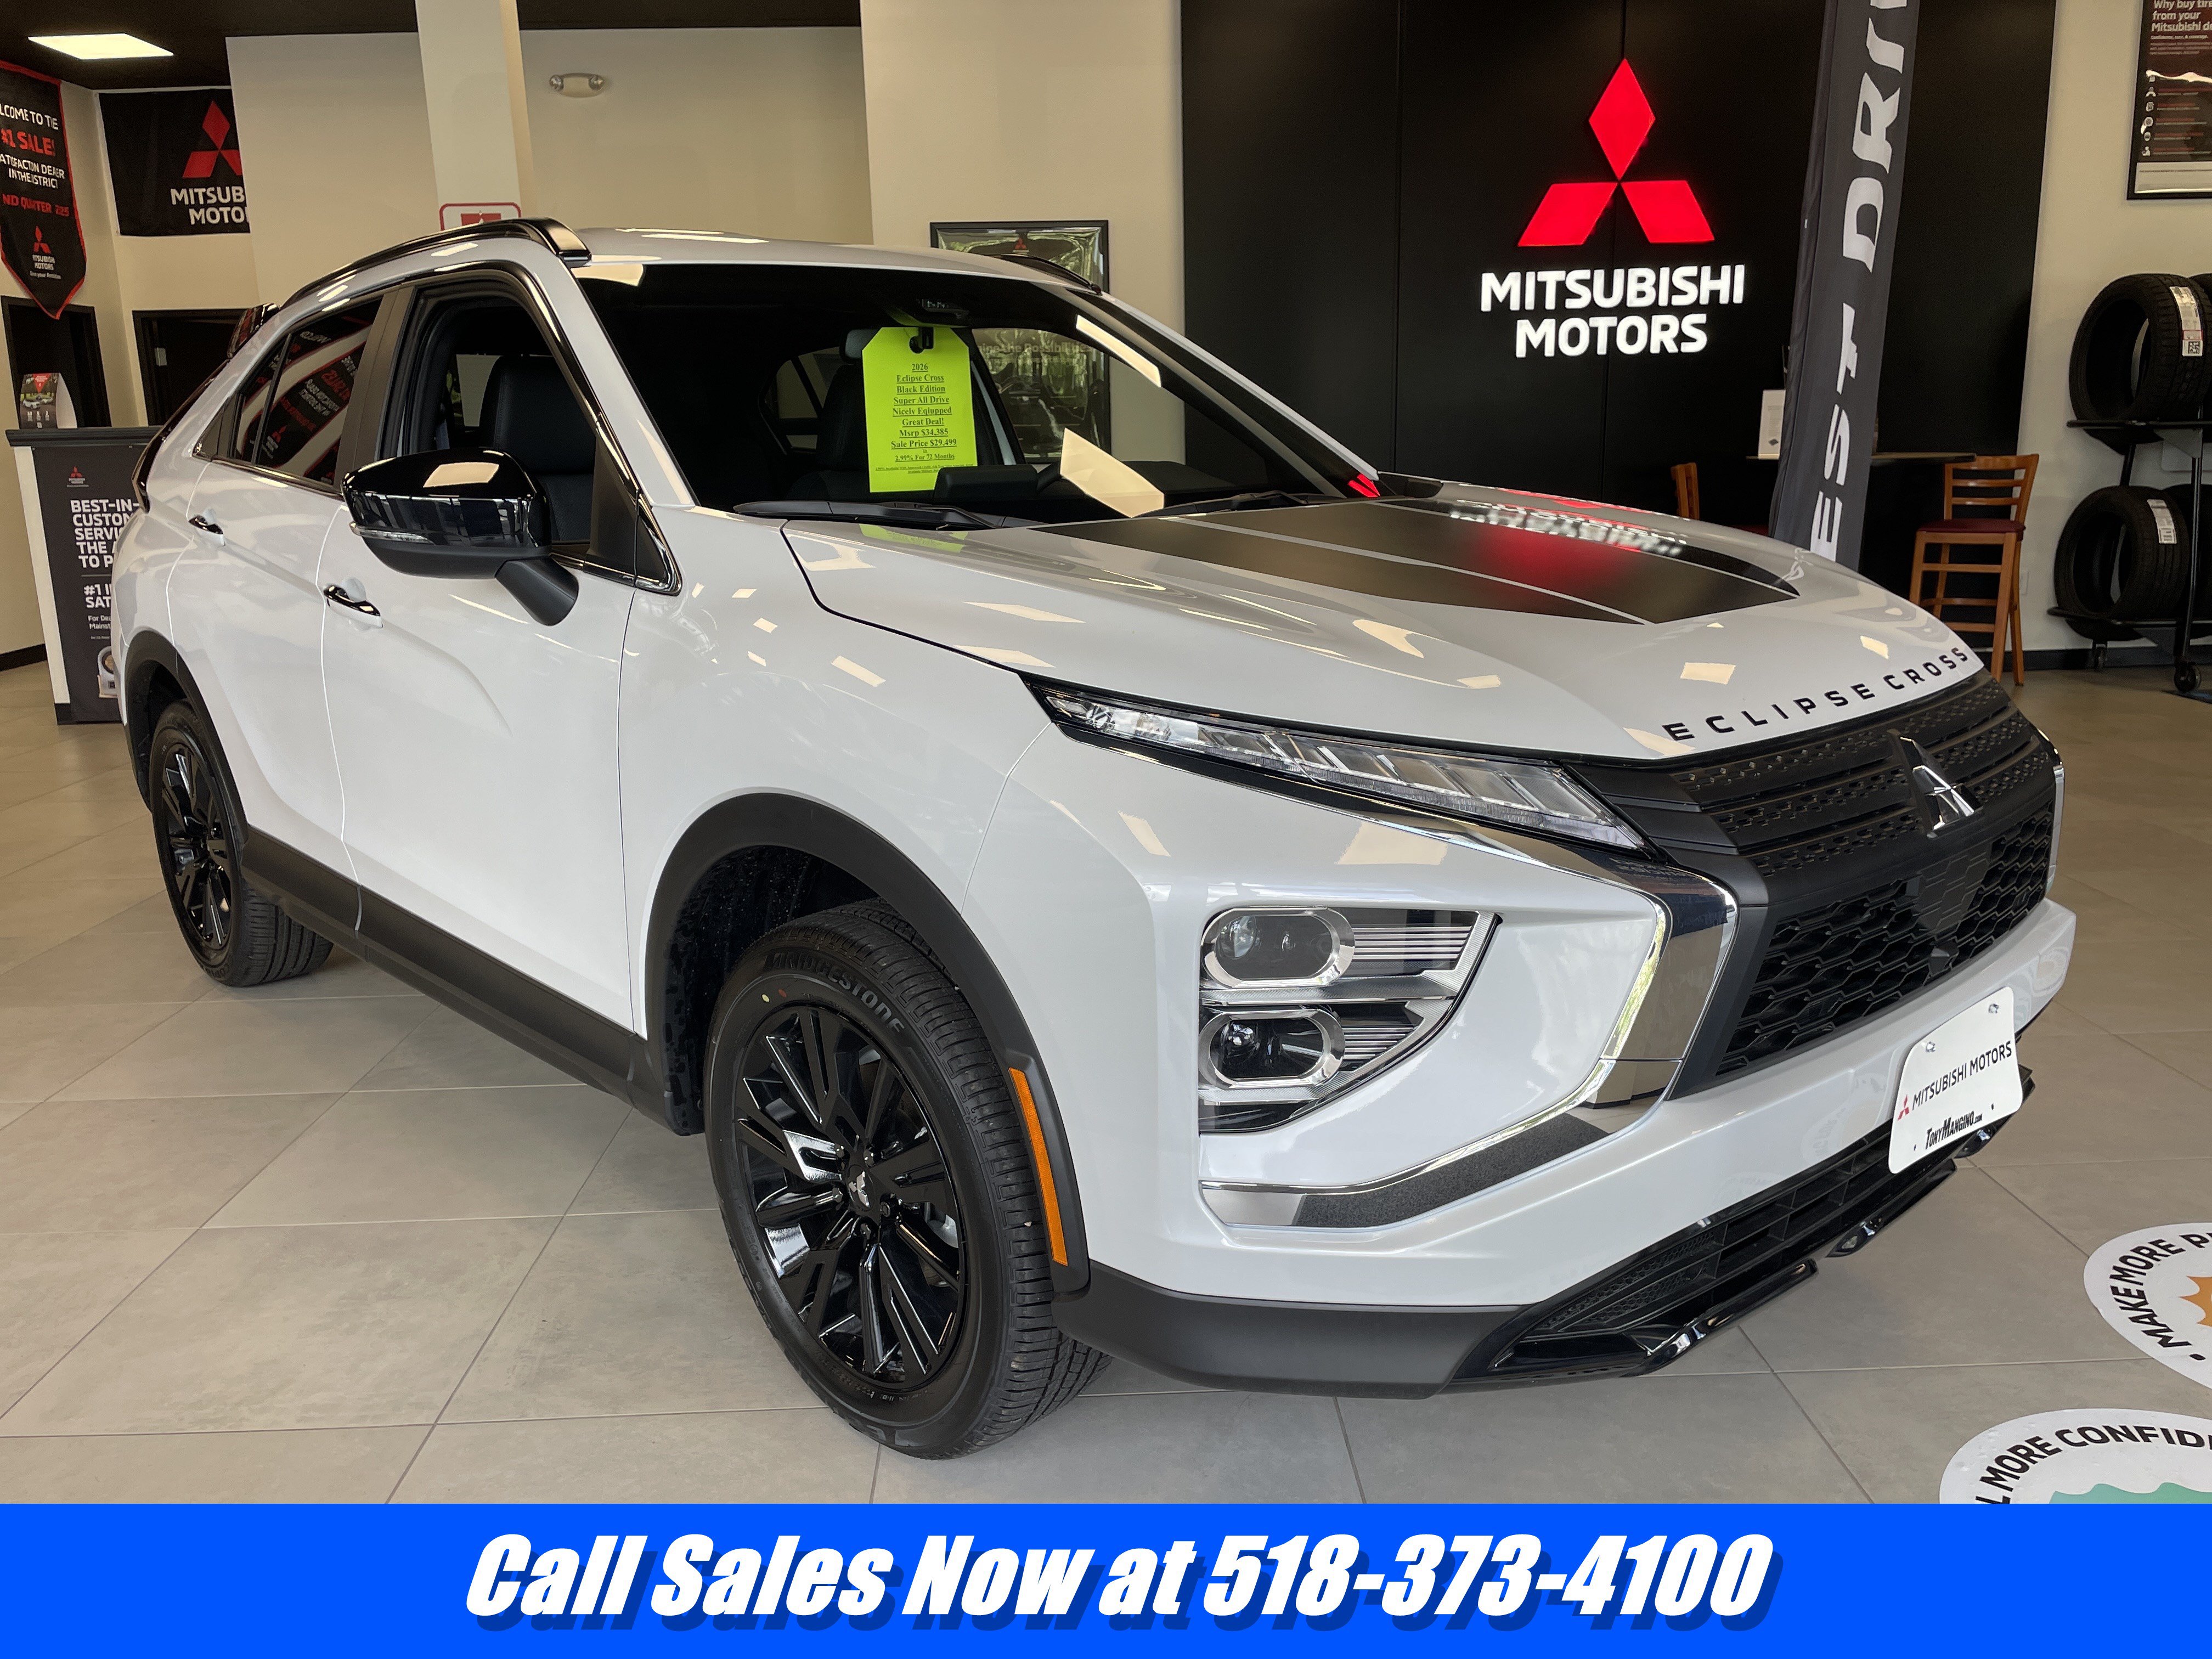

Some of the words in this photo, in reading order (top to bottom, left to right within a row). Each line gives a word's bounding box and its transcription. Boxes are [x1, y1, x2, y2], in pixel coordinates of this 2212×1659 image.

[2154, 0, 2175, 11] Why
[2177, 0, 2196, 10] buy
[2152, 10, 2176, 20] from
[2178, 12, 2202, 22] your
[2151, 21, 2202, 32] Mitsubishi
[29, 111, 43, 125] TO
[1842, 0, 1908, 273] DRI
[1481, 264, 1746, 312] MITSUBISHI
[1516, 314, 1707, 358] MOTORS
[911, 363, 928, 373] 2026
[896, 375, 922, 383] Eclipse
[924, 374, 944, 382] Cross
[897, 386, 917, 395] Black
[919, 385, 945, 394] Edition
[894, 397, 916, 406] Super
[917, 396, 928, 405] All
[930, 396, 950, 404] Drive
[893, 408, 915, 417] Nicely
[902, 419, 923, 427] Great
[926, 417, 944, 426] Deal!
[899, 430, 919, 438] Msrp
[1810, 302, 1858, 563] EST
[891, 441, 907, 449] Sale
[909, 440, 928, 448] Price
[70, 499, 140, 513] BEST-IN-
[76, 541, 108, 554] THE
[78, 555, 100, 568] TO
[83, 584, 101, 596] #1
[1662, 682, 1875, 741] ECLIPSE
[1883, 647, 1968, 691] CROSS
[1911, 1063, 1967, 1111] MITSUBISHI
[1970, 1041, 2012, 1076] MOTORS
[2179, 1232, 2212, 1249] P
[2109, 1238, 2186, 1286] MORE
[2110, 1285, 2192, 1348] MAKE
[1979, 1435, 2063, 1492] MORE
[2055, 1425, 2212, 1449] CONFID
